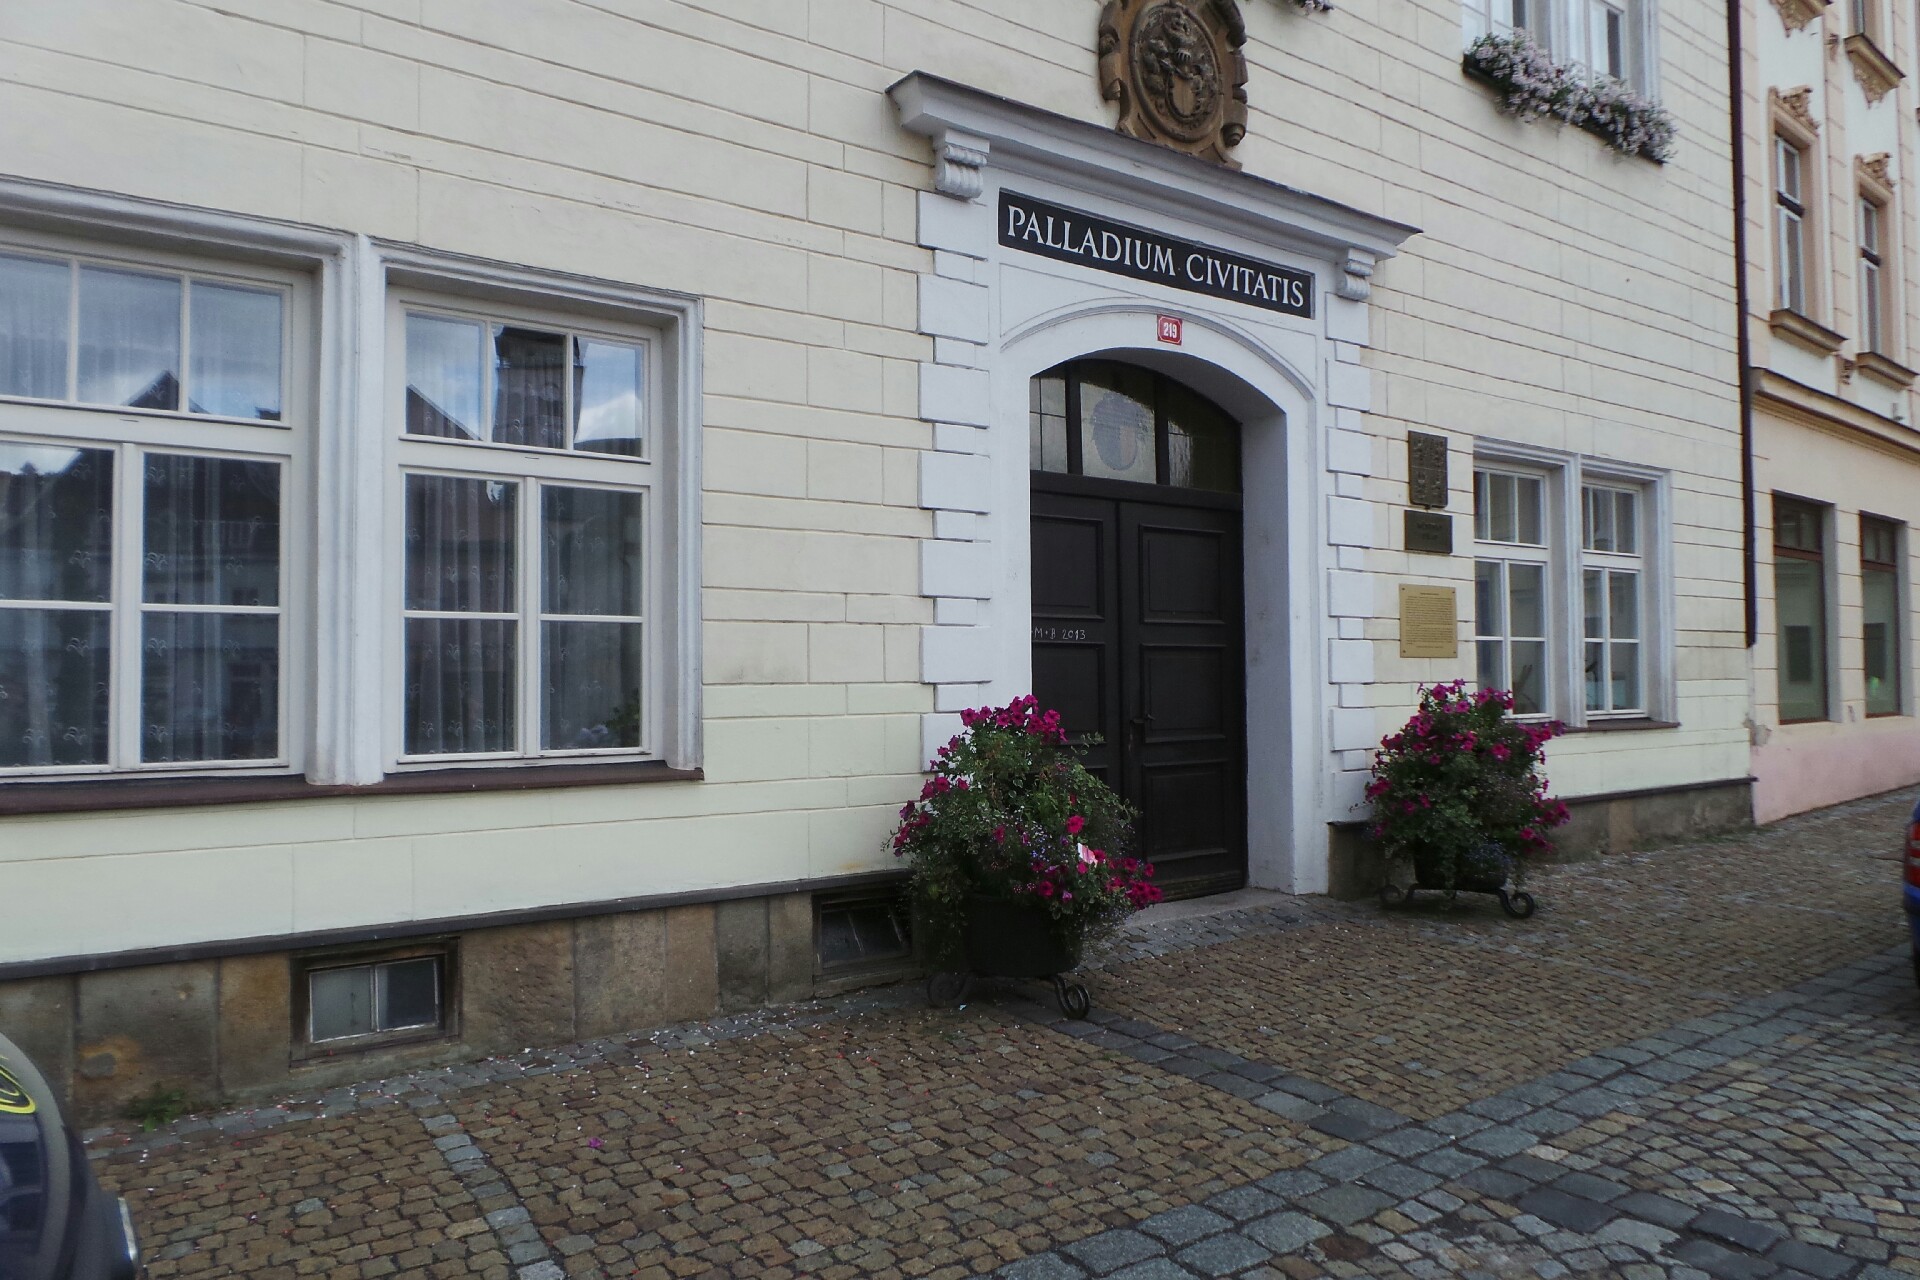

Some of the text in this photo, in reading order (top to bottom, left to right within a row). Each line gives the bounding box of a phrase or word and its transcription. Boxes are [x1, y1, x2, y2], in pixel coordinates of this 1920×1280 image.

[1007, 205, 1304, 308] PALLADIUM CIVITATIS
[1163, 322, 1178, 338] 219
[1062, 629, 1086, 640] 2013
